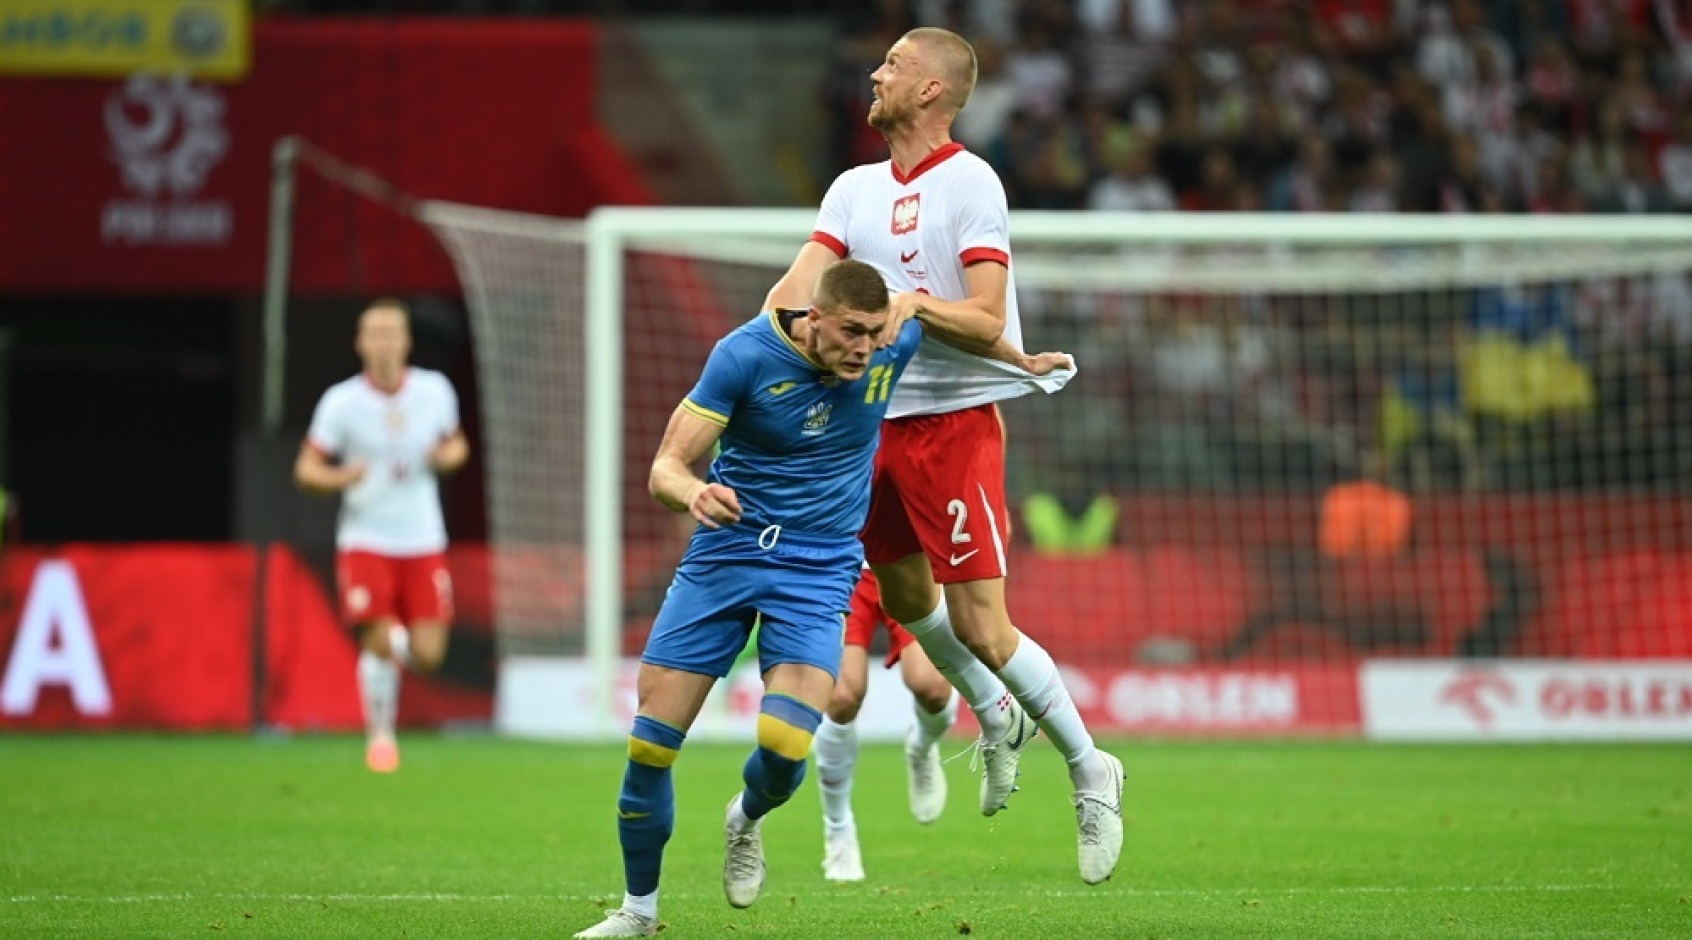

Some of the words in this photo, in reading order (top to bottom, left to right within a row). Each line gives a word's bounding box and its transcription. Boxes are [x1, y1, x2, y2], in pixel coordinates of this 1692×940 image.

[864, 363, 894, 404] 11
[947, 499, 971, 544] 2
[1, 558, 112, 715] A
